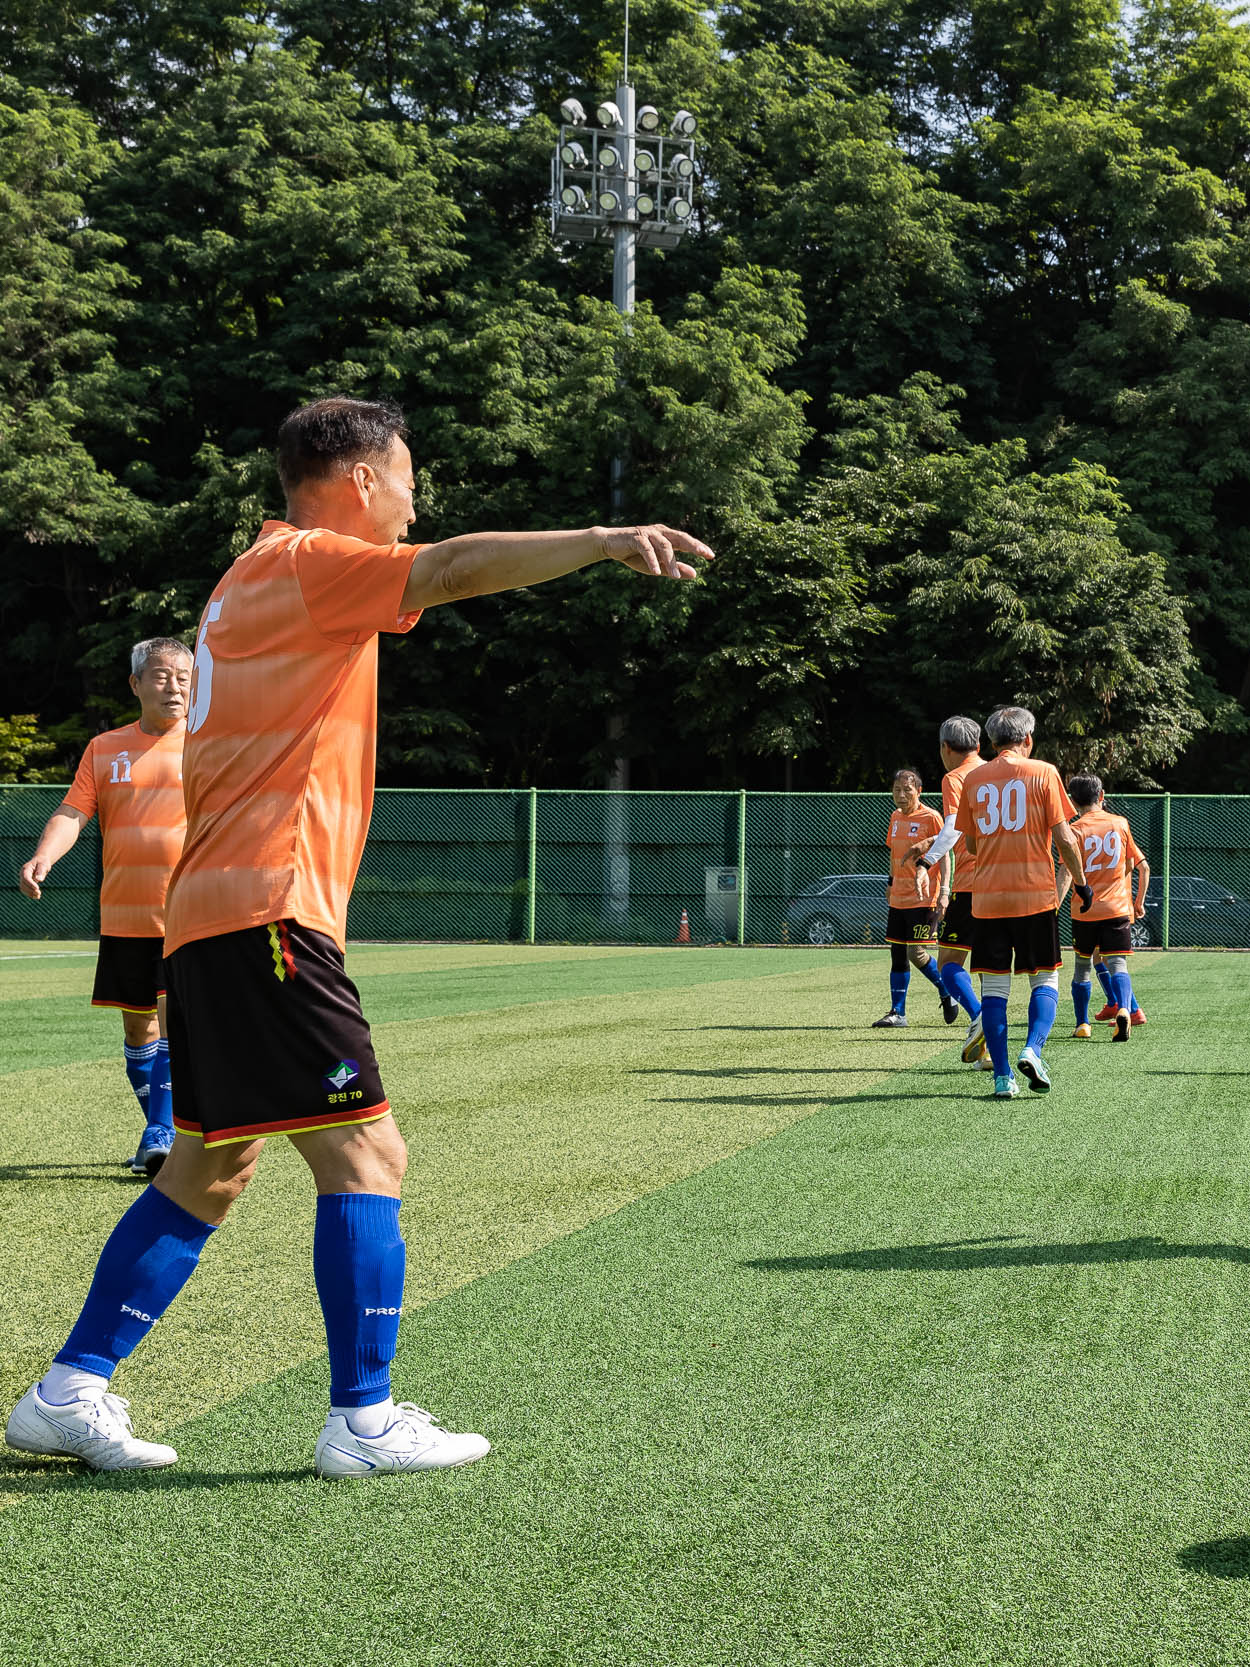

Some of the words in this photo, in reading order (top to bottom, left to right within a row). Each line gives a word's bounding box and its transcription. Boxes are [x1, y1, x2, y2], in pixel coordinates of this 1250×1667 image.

[109, 761, 132, 784] 11
[976, 779, 1027, 835] 30
[1084, 830, 1122, 873] 29
[913, 924, 931, 940] 12
[327, 1092, 348, 1104] 광진
[350, 1090, 363, 1100] 70
